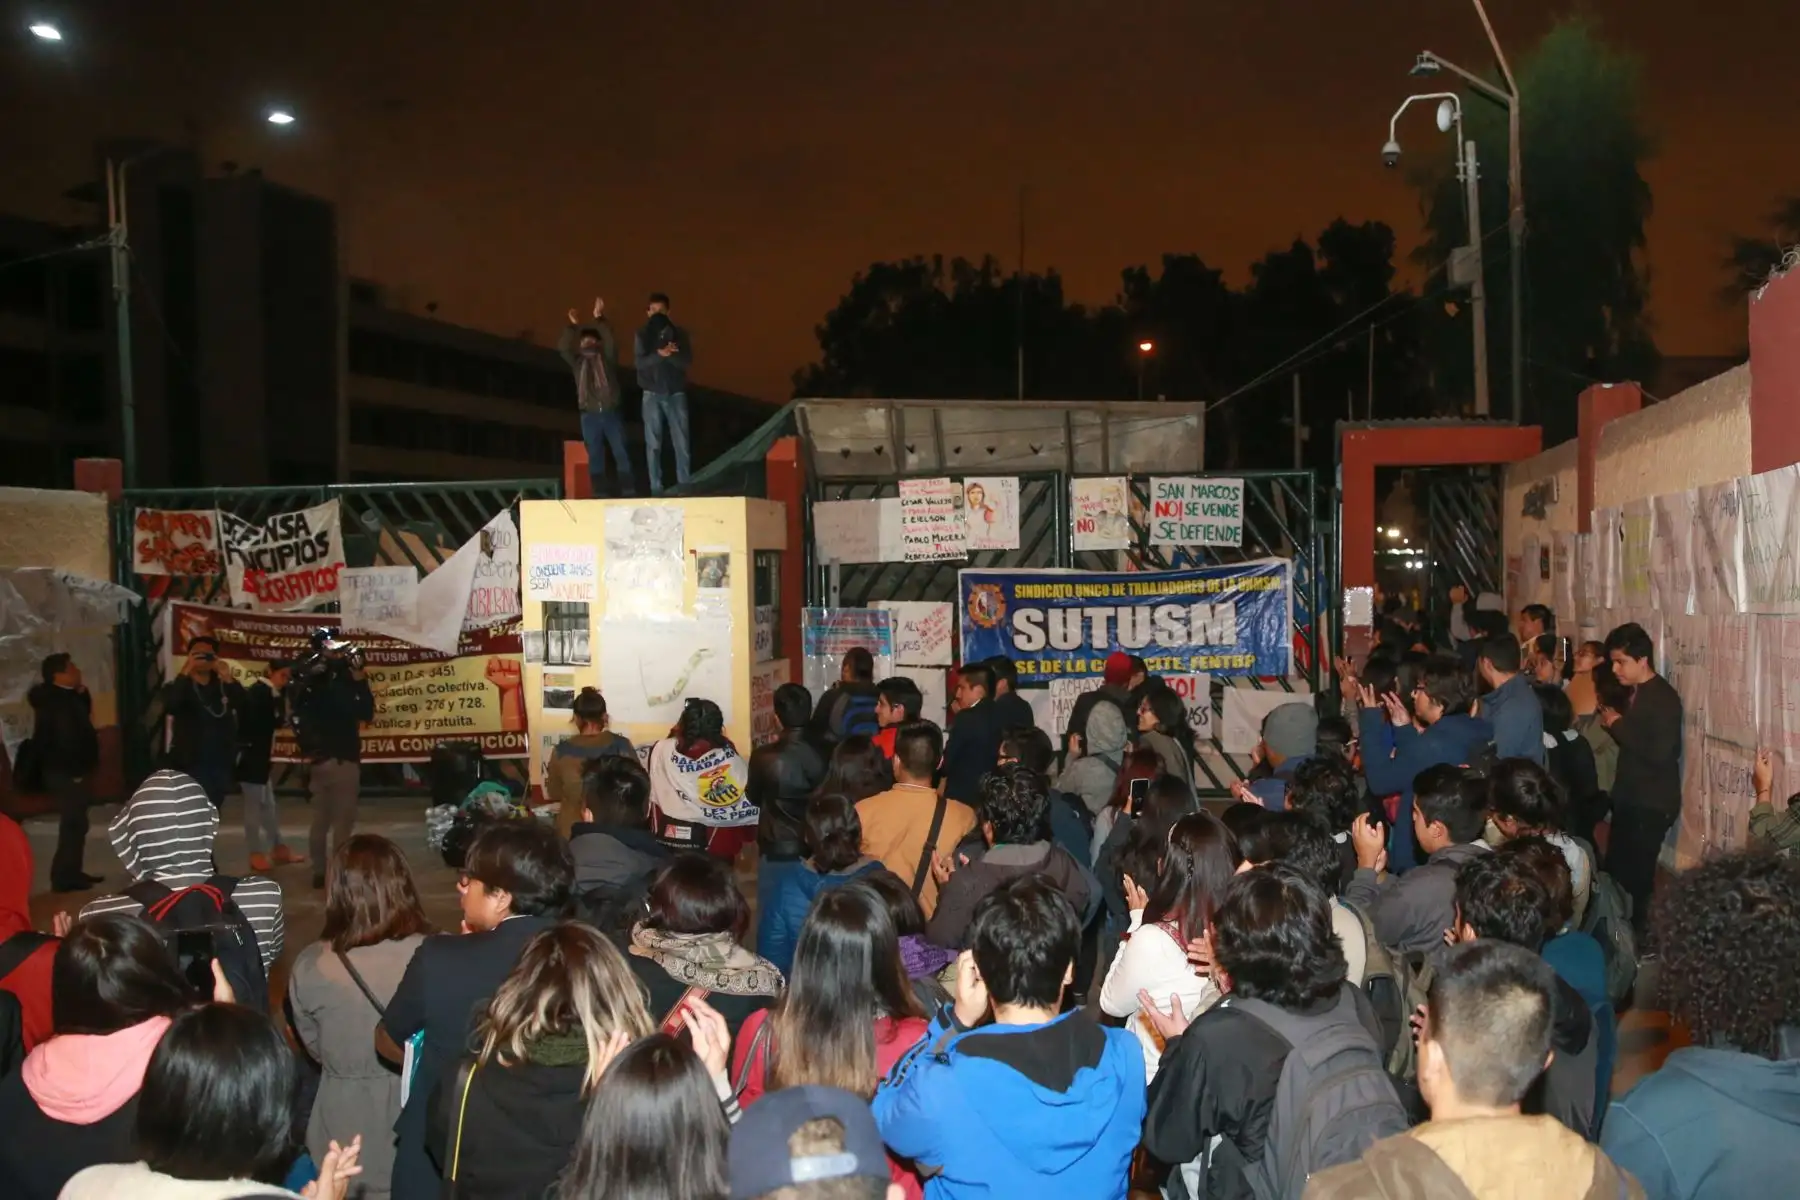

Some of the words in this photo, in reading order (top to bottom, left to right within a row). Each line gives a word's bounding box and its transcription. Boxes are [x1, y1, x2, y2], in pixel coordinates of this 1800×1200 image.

[1157, 483, 1185, 499] SAN
[1190, 484, 1240, 500] MARCOS
[1155, 500, 1183, 521] NO!
[1185, 502, 1200, 516] SE
[1202, 503, 1240, 518] VENDE
[1076, 518, 1095, 534] NO
[1154, 521, 1178, 540] SE
[1180, 525, 1241, 543] DEFIENDE
[904, 535, 930, 545] PABLO
[1014, 584, 1072, 599] SINDICATO
[1075, 584, 1110, 597] UNICO
[1112, 583, 1126, 596] DE
[1128, 578, 1205, 596] TRABAJADORES
[233, 620, 304, 634] UNIVERSIDAD
[1012, 601, 1237, 651] SUTUSM
[1015, 660, 1036, 674] SE
[1039, 660, 1062, 674] DE
[1066, 660, 1087, 673] LA
[447, 702, 455, 712] y
[413, 720, 422, 730] y
[400, 732, 528, 752] CONCIÓN
